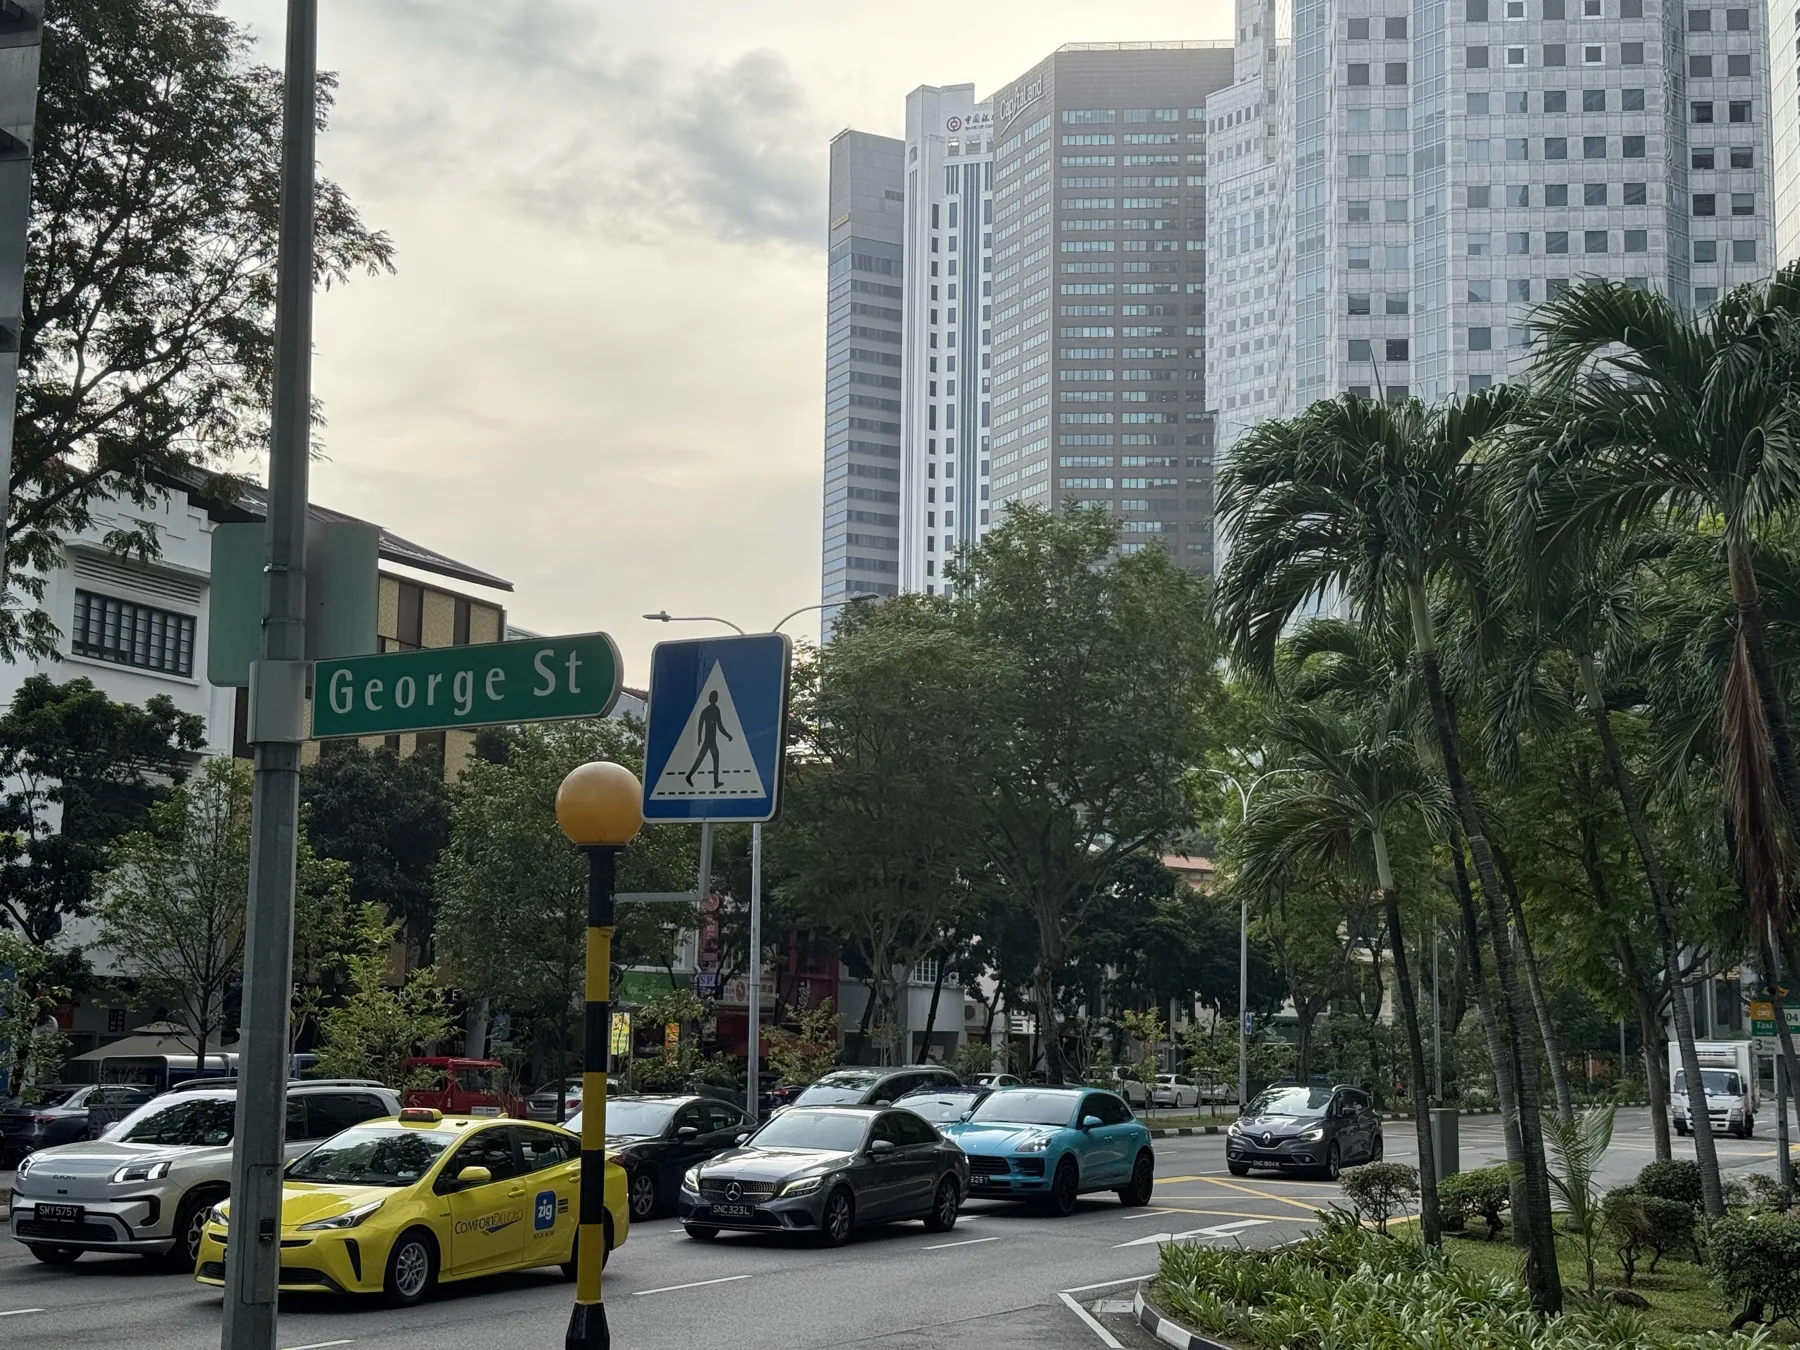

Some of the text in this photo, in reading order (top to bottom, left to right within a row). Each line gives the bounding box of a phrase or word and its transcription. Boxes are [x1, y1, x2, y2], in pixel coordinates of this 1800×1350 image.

[1000, 74, 1042, 120] CapitaLand
[329, 649, 582, 716] George St
[1756, 1021, 1773, 1029] Taxi
[1755, 1038, 1763, 1051] 3
[39, 1205, 79, 1217] SMY575Y
[537, 1199, 553, 1220] zig
